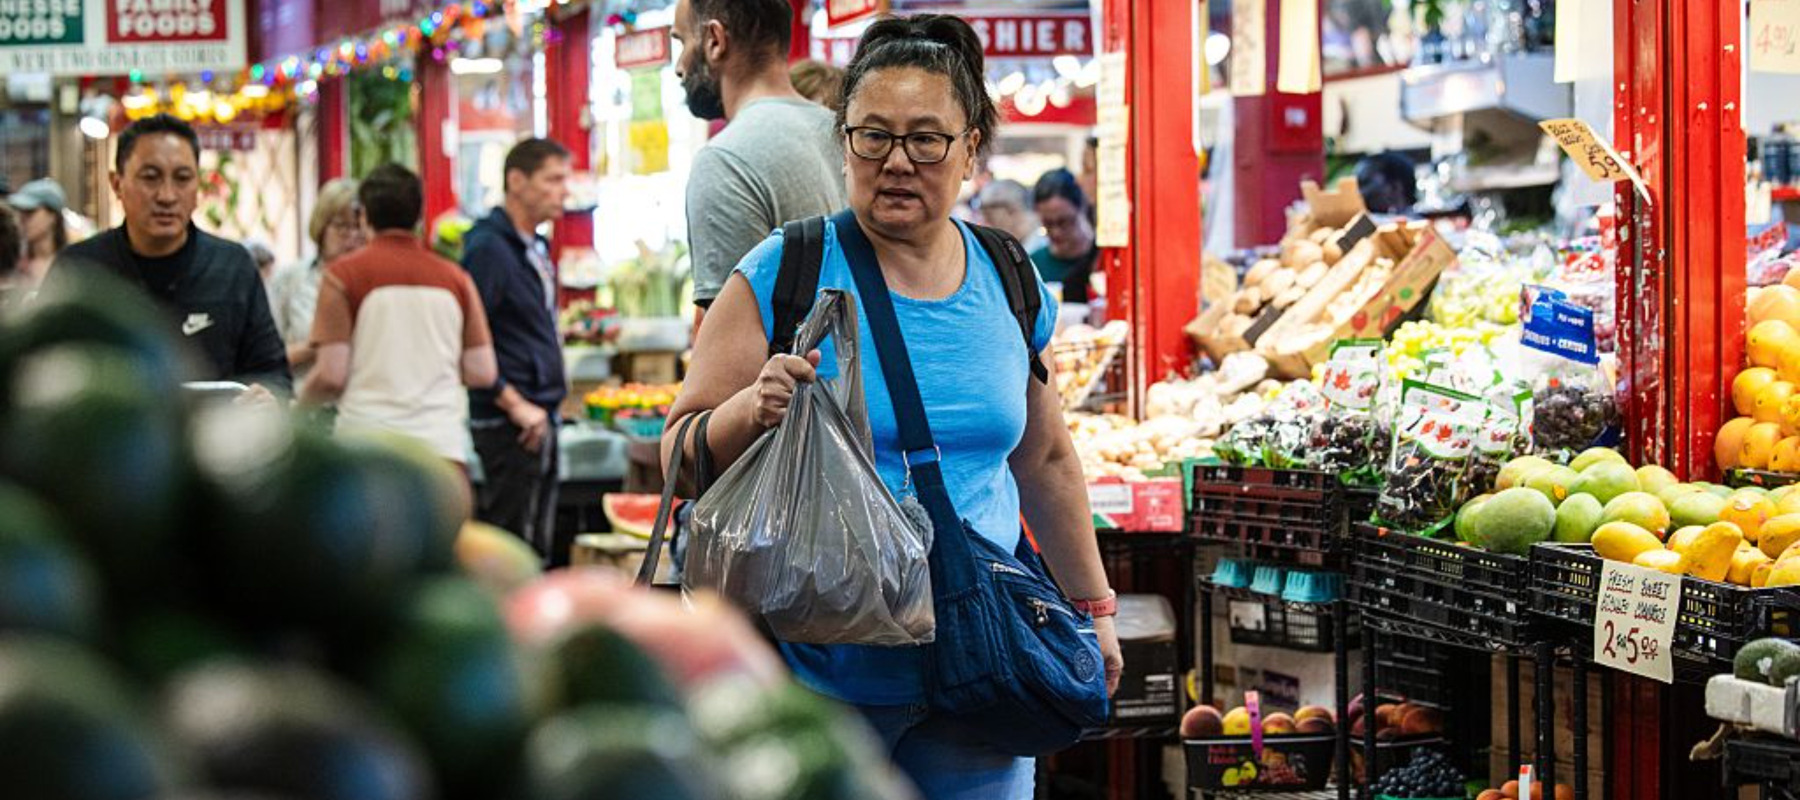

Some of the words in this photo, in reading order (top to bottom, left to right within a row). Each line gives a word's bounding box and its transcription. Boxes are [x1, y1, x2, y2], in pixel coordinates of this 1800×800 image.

[117, 0, 213, 14] FAMILY
[0, 16, 65, 40] OODS
[118, 12, 216, 37] FOODS
[1603, 620, 1616, 658] 2
